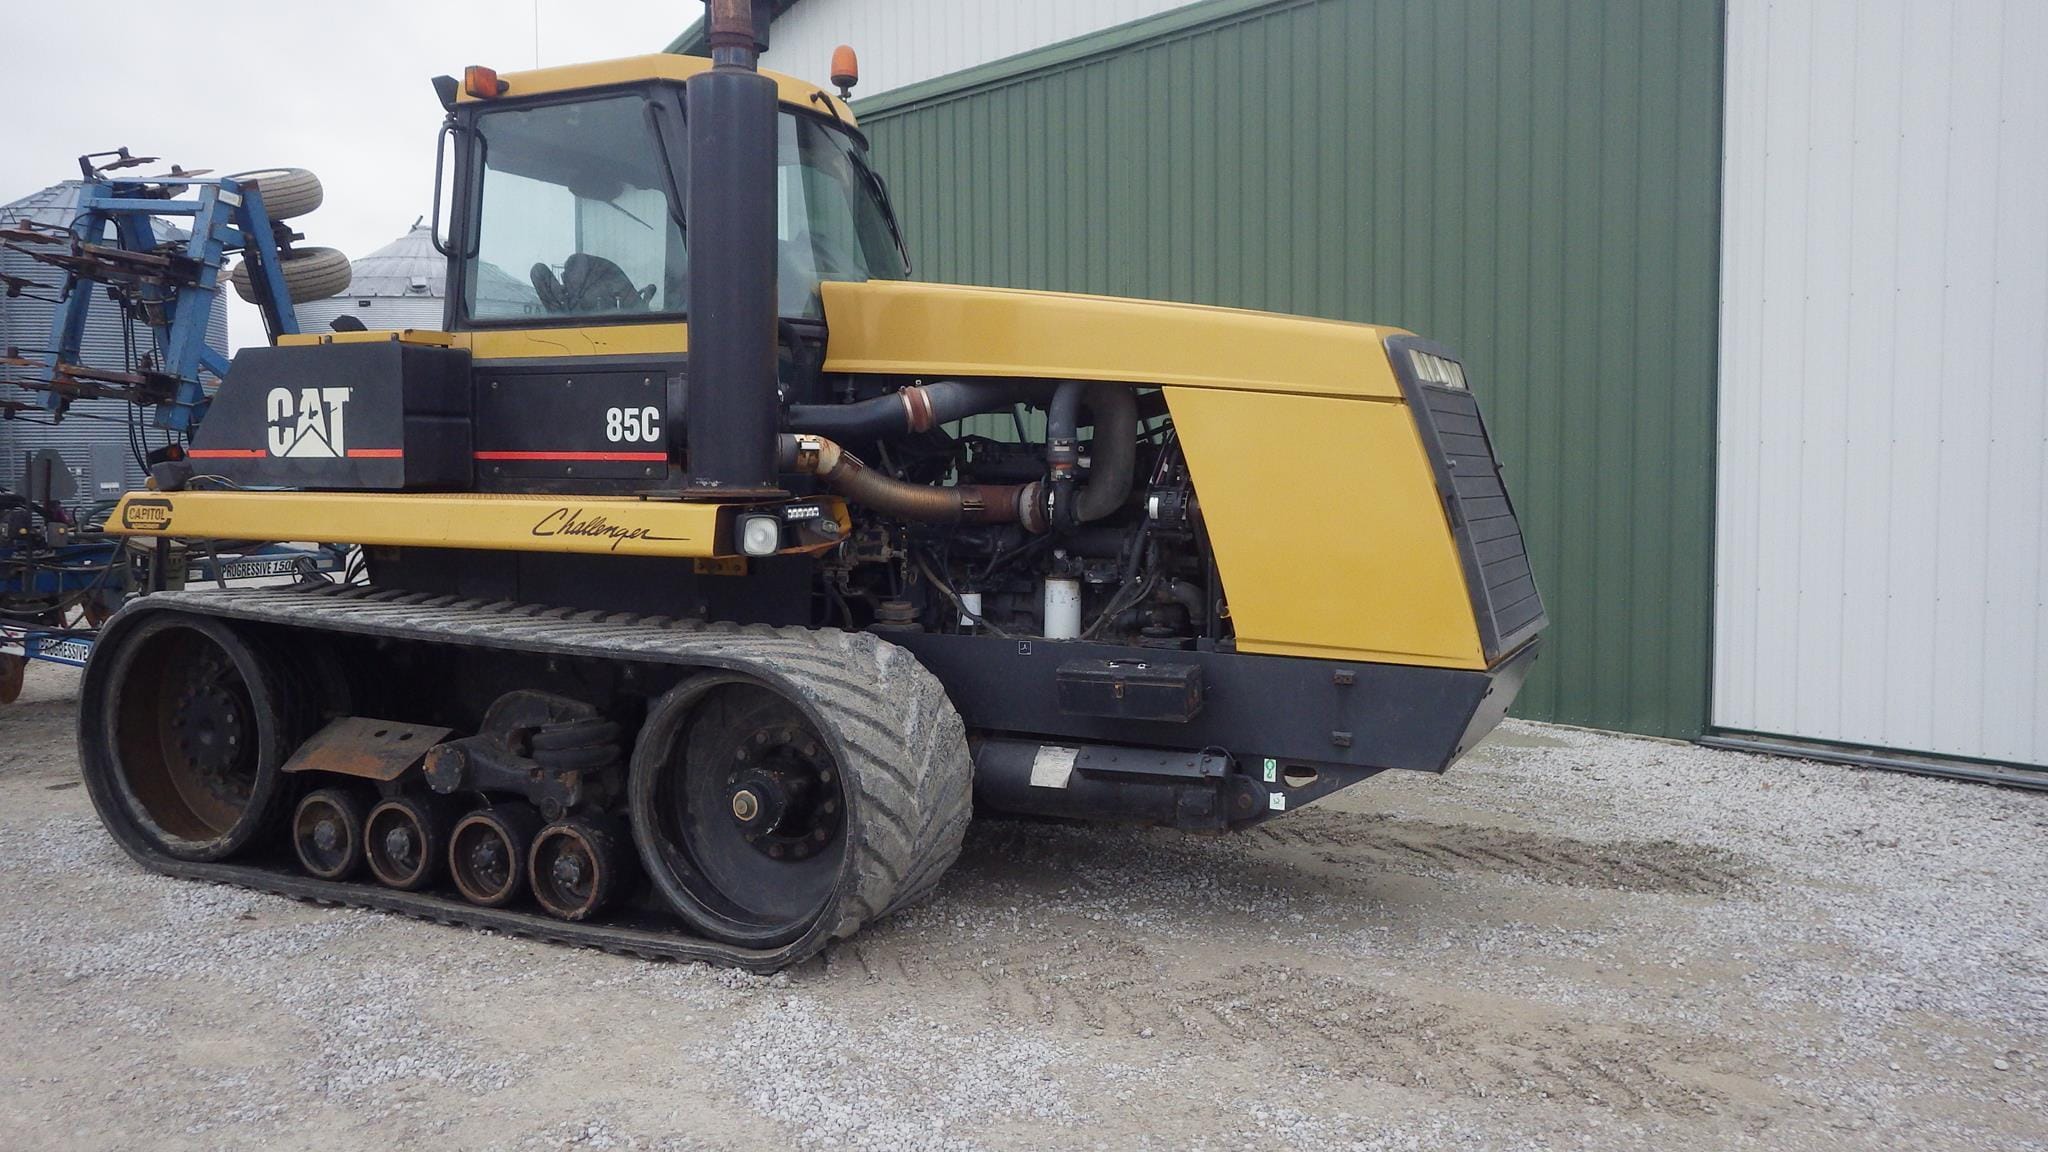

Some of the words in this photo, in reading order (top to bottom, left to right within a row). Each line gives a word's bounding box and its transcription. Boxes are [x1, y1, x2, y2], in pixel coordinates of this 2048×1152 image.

[267, 387, 350, 457] CAT
[606, 406, 660, 442] 85C
[129, 507, 165, 521] CAPITOL
[532, 507, 691, 551] Challenger
[222, 562, 272, 578] PROGRESSIVE
